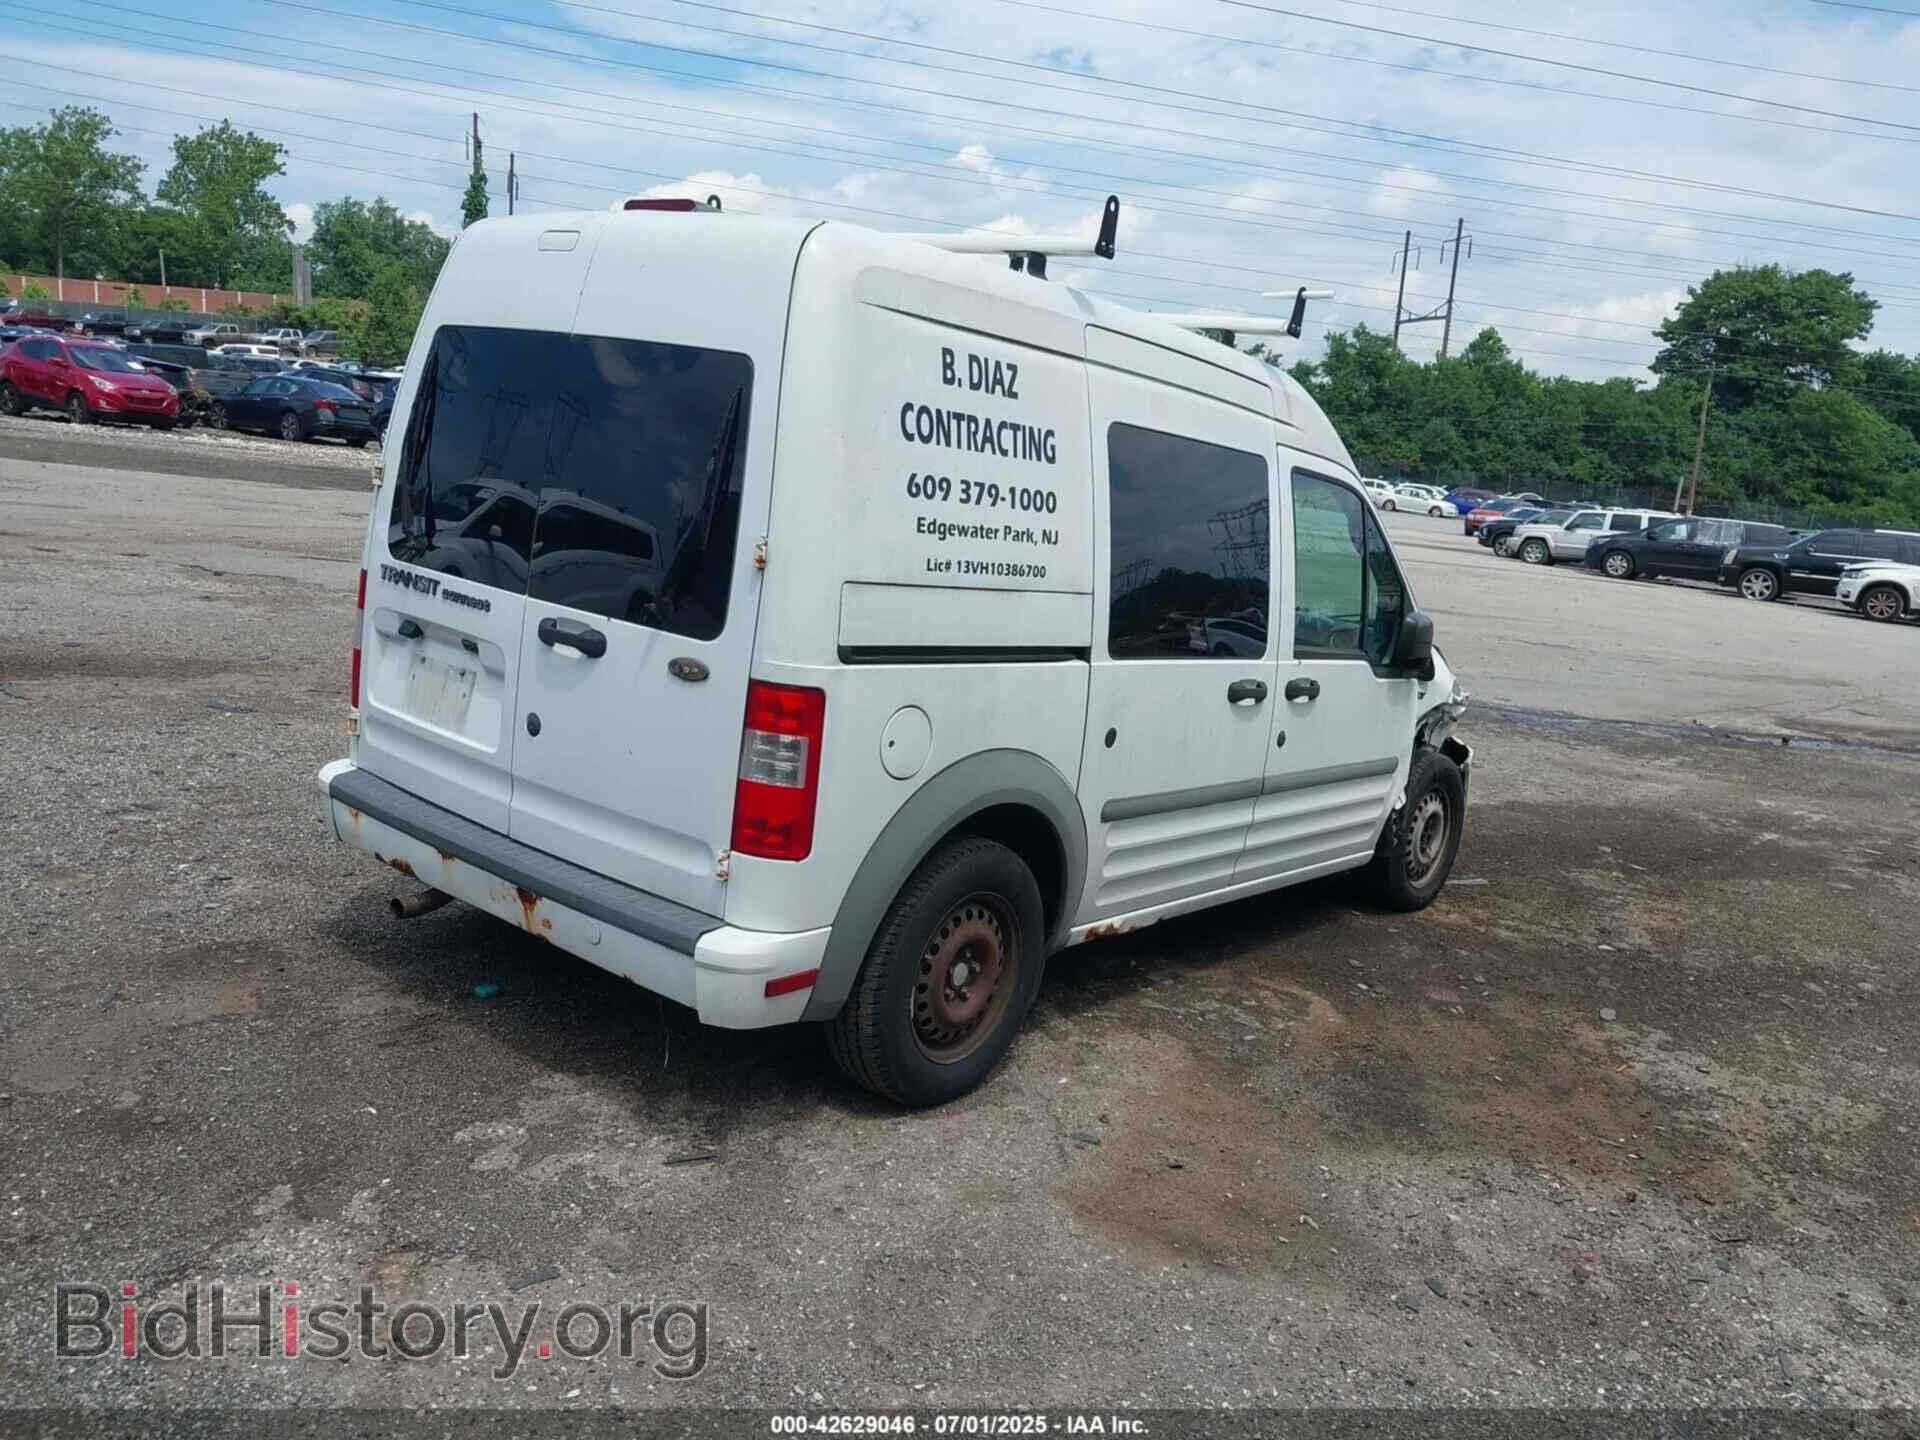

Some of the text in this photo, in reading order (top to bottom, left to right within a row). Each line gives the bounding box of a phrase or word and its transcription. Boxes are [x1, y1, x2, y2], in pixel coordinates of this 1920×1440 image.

[941, 347, 1019, 400] B. DIAZ
[900, 402, 1057, 465] CONTRACTING
[906, 473, 1057, 515] 609 379-1000
[916, 516, 1059, 547] Edgewater Park, NJ
[380, 563, 441, 597] TRANSIT
[926, 558, 1047, 578] Lic# 13VH10386700
